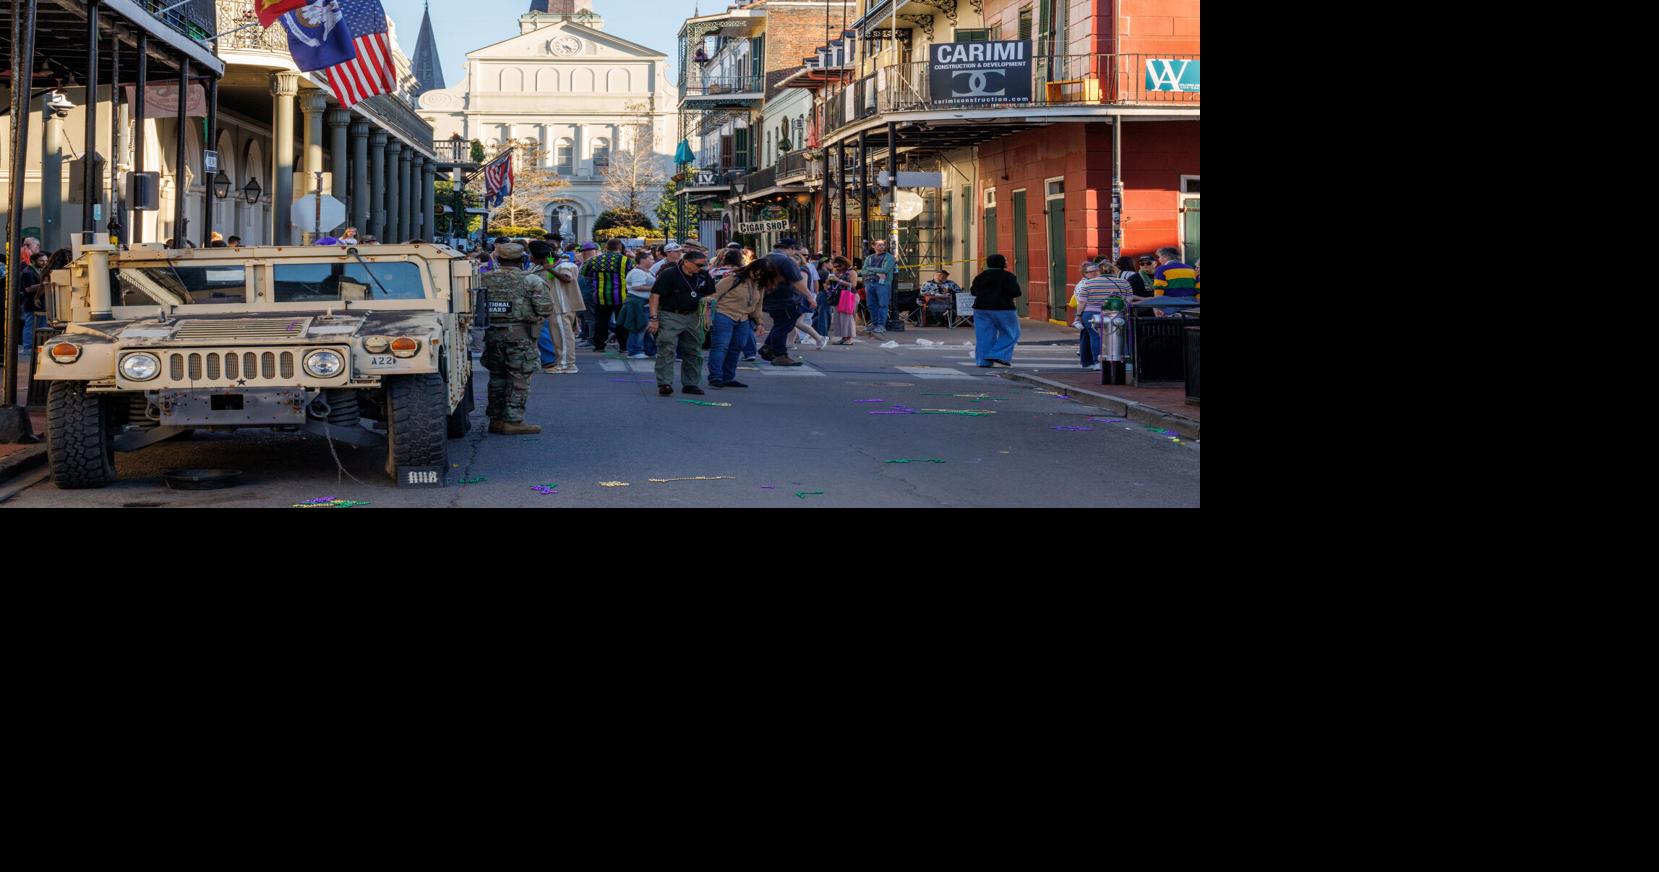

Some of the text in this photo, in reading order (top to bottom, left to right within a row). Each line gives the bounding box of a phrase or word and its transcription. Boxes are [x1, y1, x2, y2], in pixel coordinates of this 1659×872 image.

[937, 42, 1024, 63] CARIMI
[740, 220, 787, 232] CIGAR SHOP
